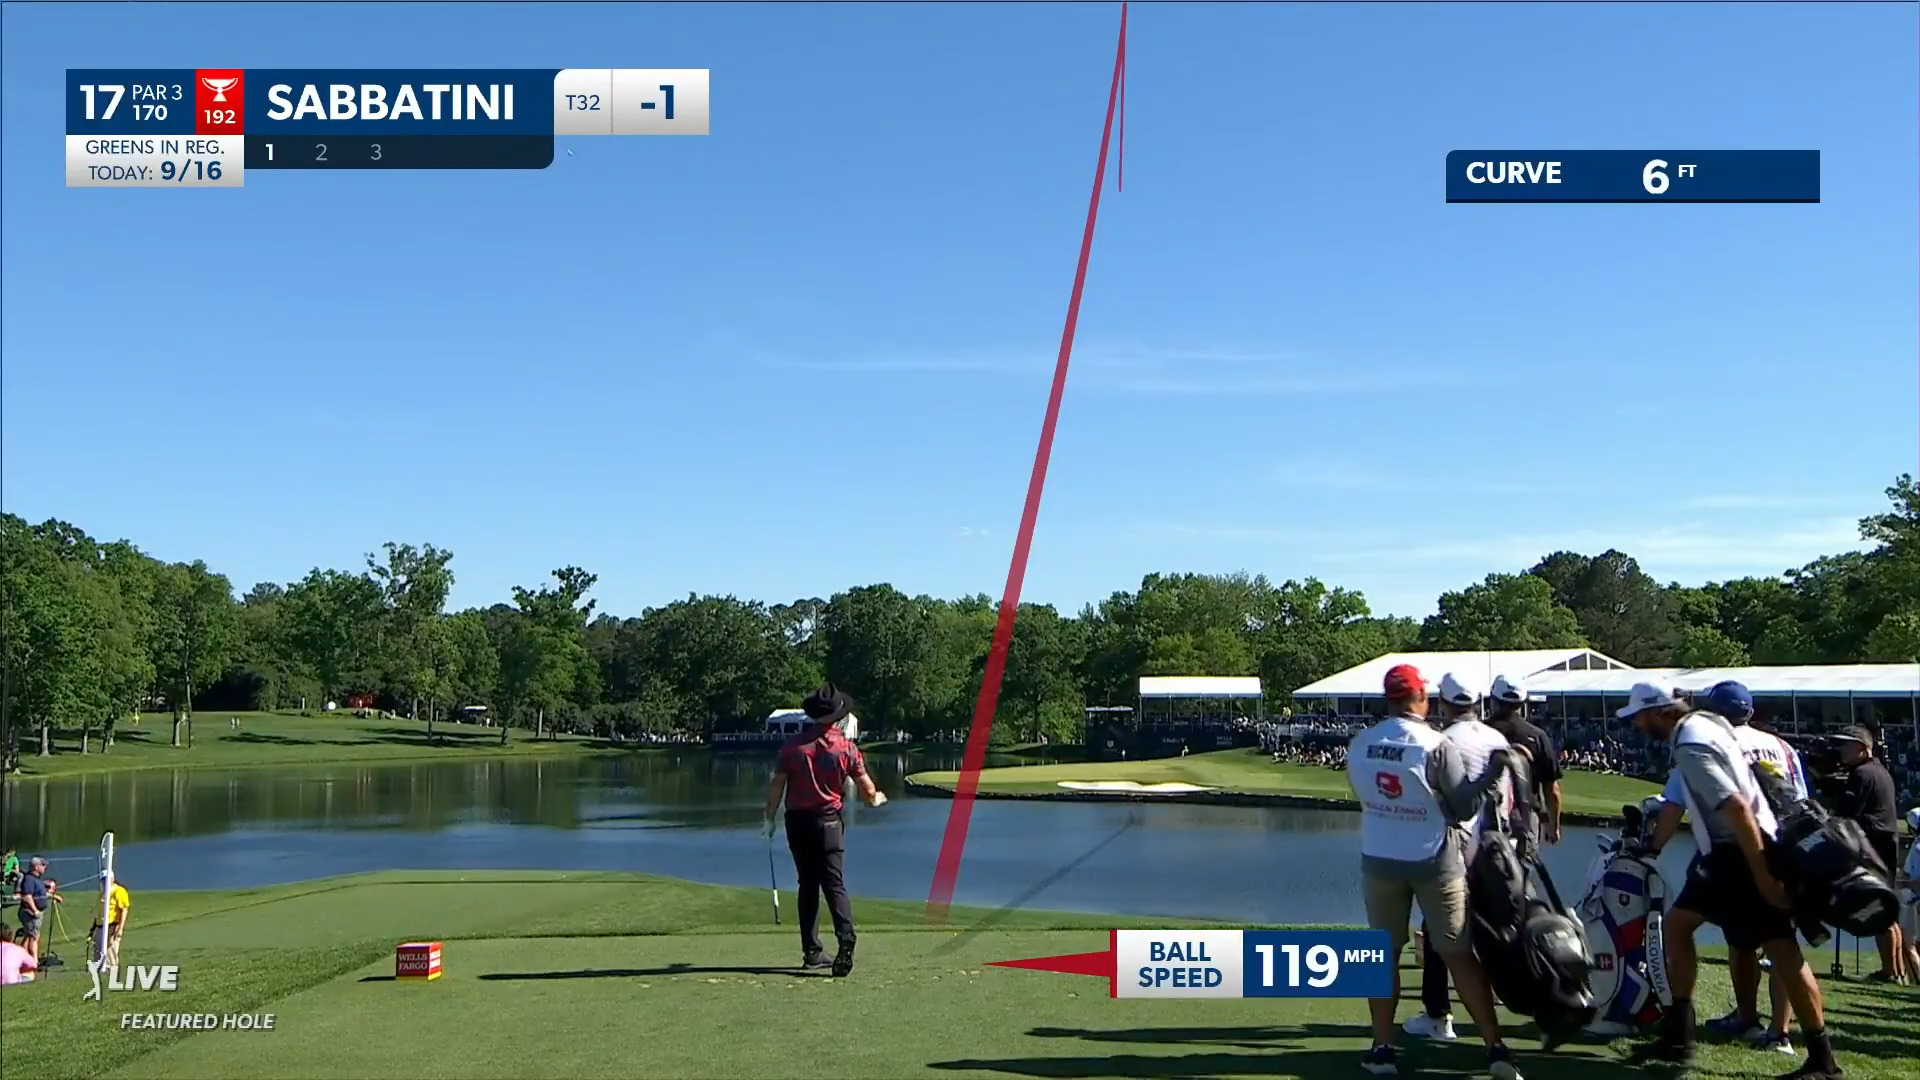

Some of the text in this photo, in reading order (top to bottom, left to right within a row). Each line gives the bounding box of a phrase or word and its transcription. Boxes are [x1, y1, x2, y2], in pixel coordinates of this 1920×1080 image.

[398, 952, 428, 961] WELLS
[399, 962, 428, 970] FARGO
[1648, 935, 1666, 993] SLOVAKIA
